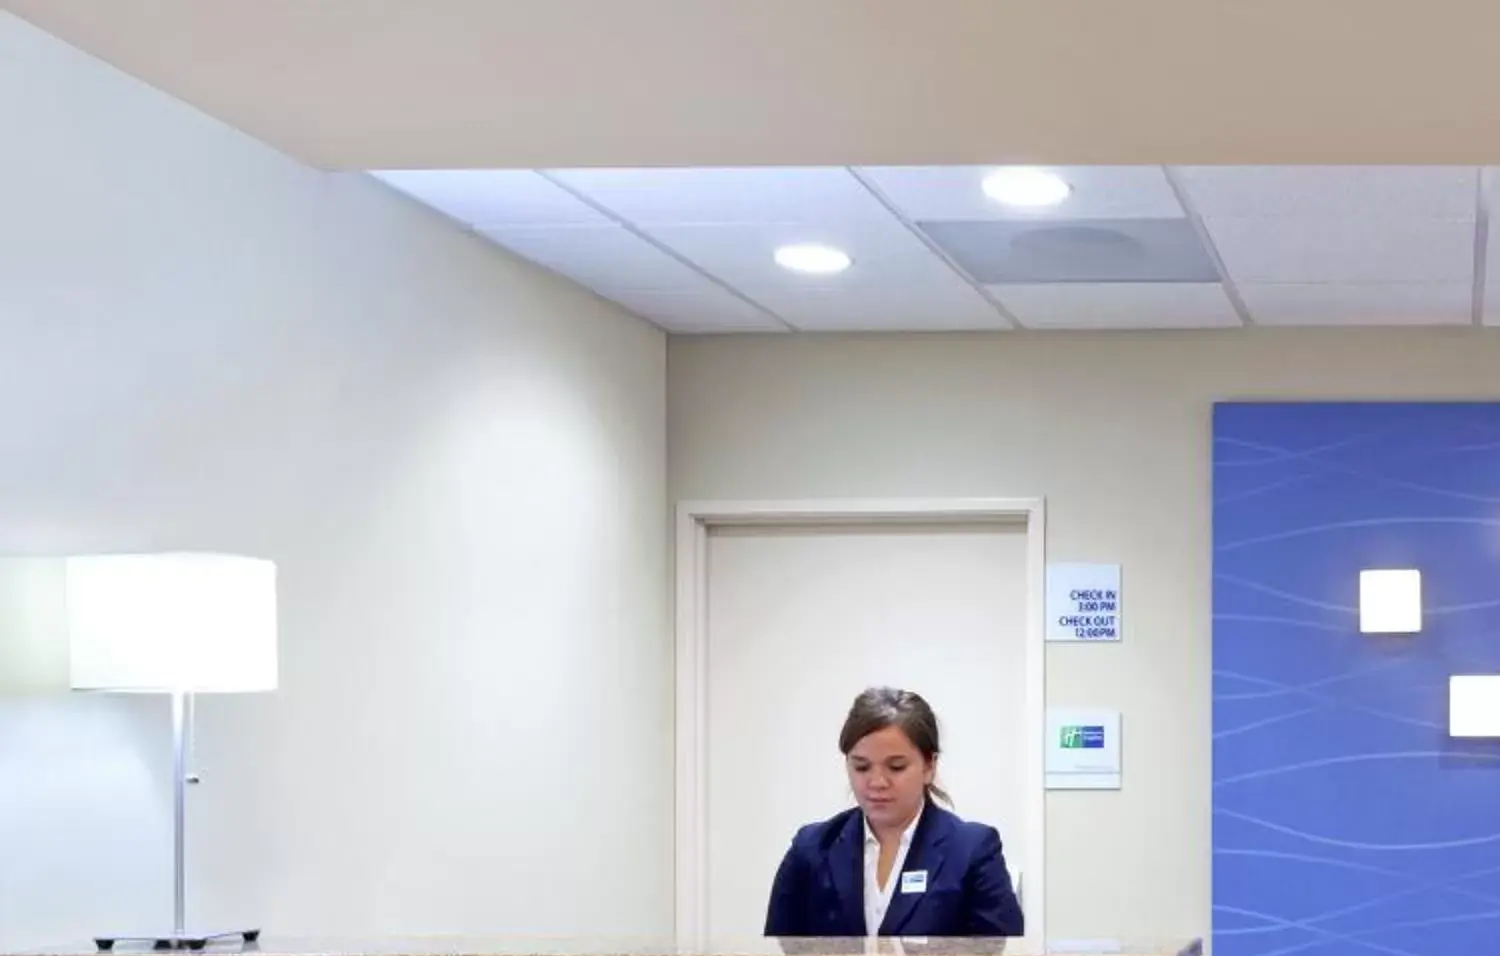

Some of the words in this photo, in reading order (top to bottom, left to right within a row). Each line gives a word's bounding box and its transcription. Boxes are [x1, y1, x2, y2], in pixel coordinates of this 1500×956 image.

[1069, 589, 1102, 601] CHECK
[1105, 590, 1116, 600] IN
[1100, 601, 1116, 611] PM
[1059, 615, 1092, 627] CHECK
[1093, 615, 1115, 627] OUT
